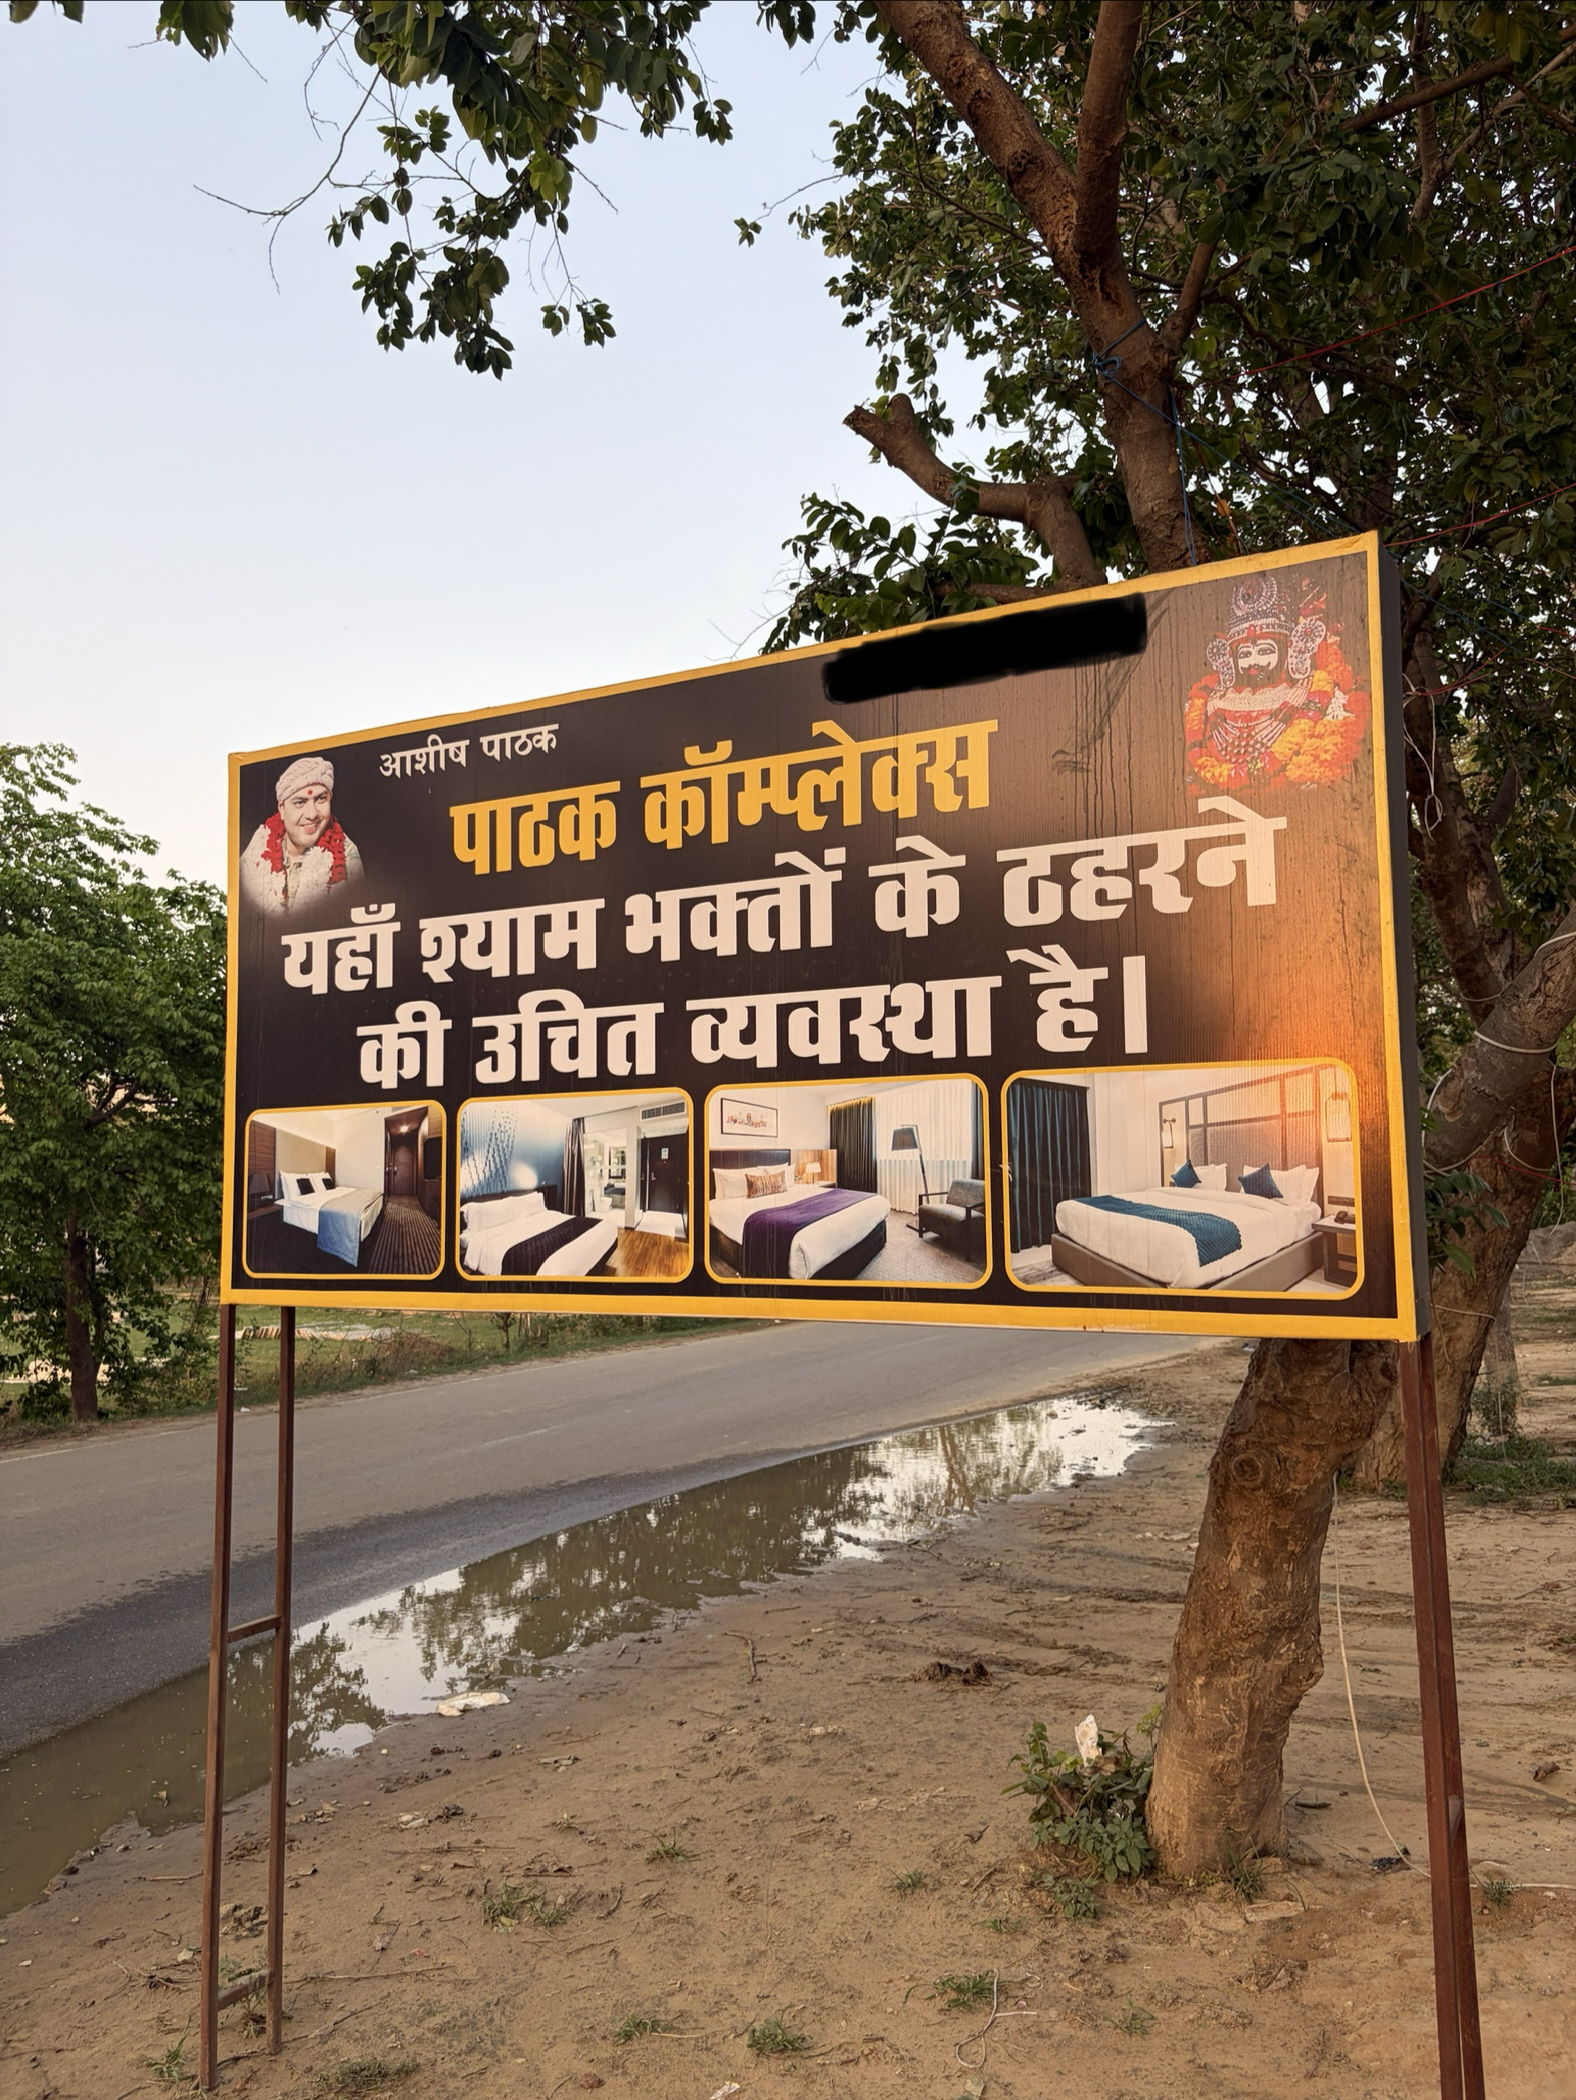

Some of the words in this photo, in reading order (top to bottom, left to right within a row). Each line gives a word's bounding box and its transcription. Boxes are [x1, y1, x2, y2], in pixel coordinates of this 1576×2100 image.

[379, 734, 469, 779] आशीष
[480, 724, 559, 763] पाठक
[449, 781, 621, 876] पाठक
[640, 719, 998, 850] कॉम्प्लेक्स
[281, 903, 401, 995] यहाँ
[419, 898, 605, 984] श्याम
[624, 847, 847, 963] भक्तों
[868, 835, 966, 938] के
[996, 795, 1287, 928] ठहरने
[356, 1001, 452, 1089] की
[472, 989, 665, 1085] उचित
[686, 976, 1002, 1069] व्यवस्था
